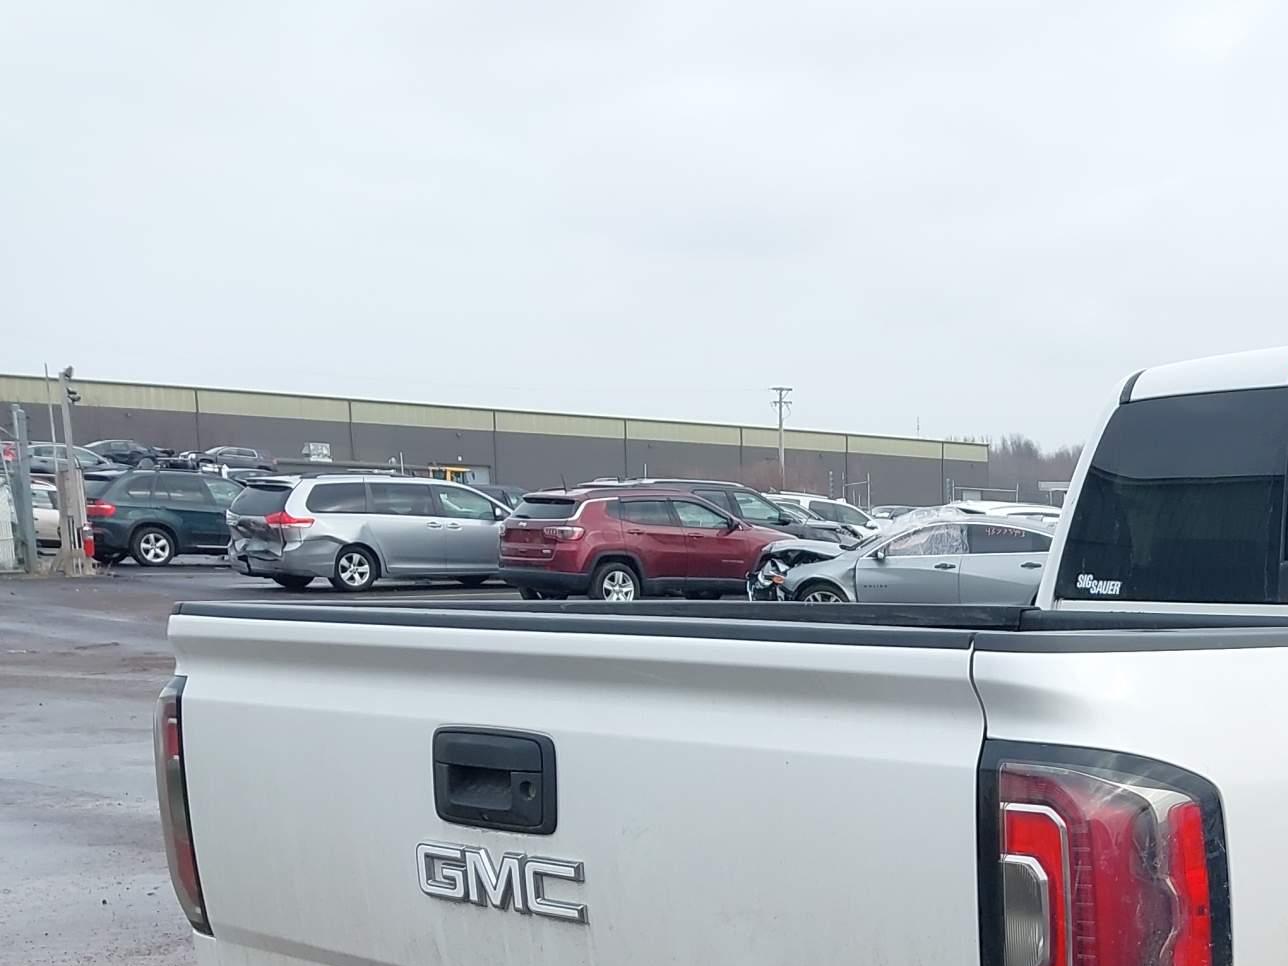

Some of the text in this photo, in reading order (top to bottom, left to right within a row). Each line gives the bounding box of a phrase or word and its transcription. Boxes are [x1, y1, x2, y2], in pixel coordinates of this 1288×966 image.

[1076, 574, 1122, 595] SIG SAUER
[416, 841, 589, 924] GMC
